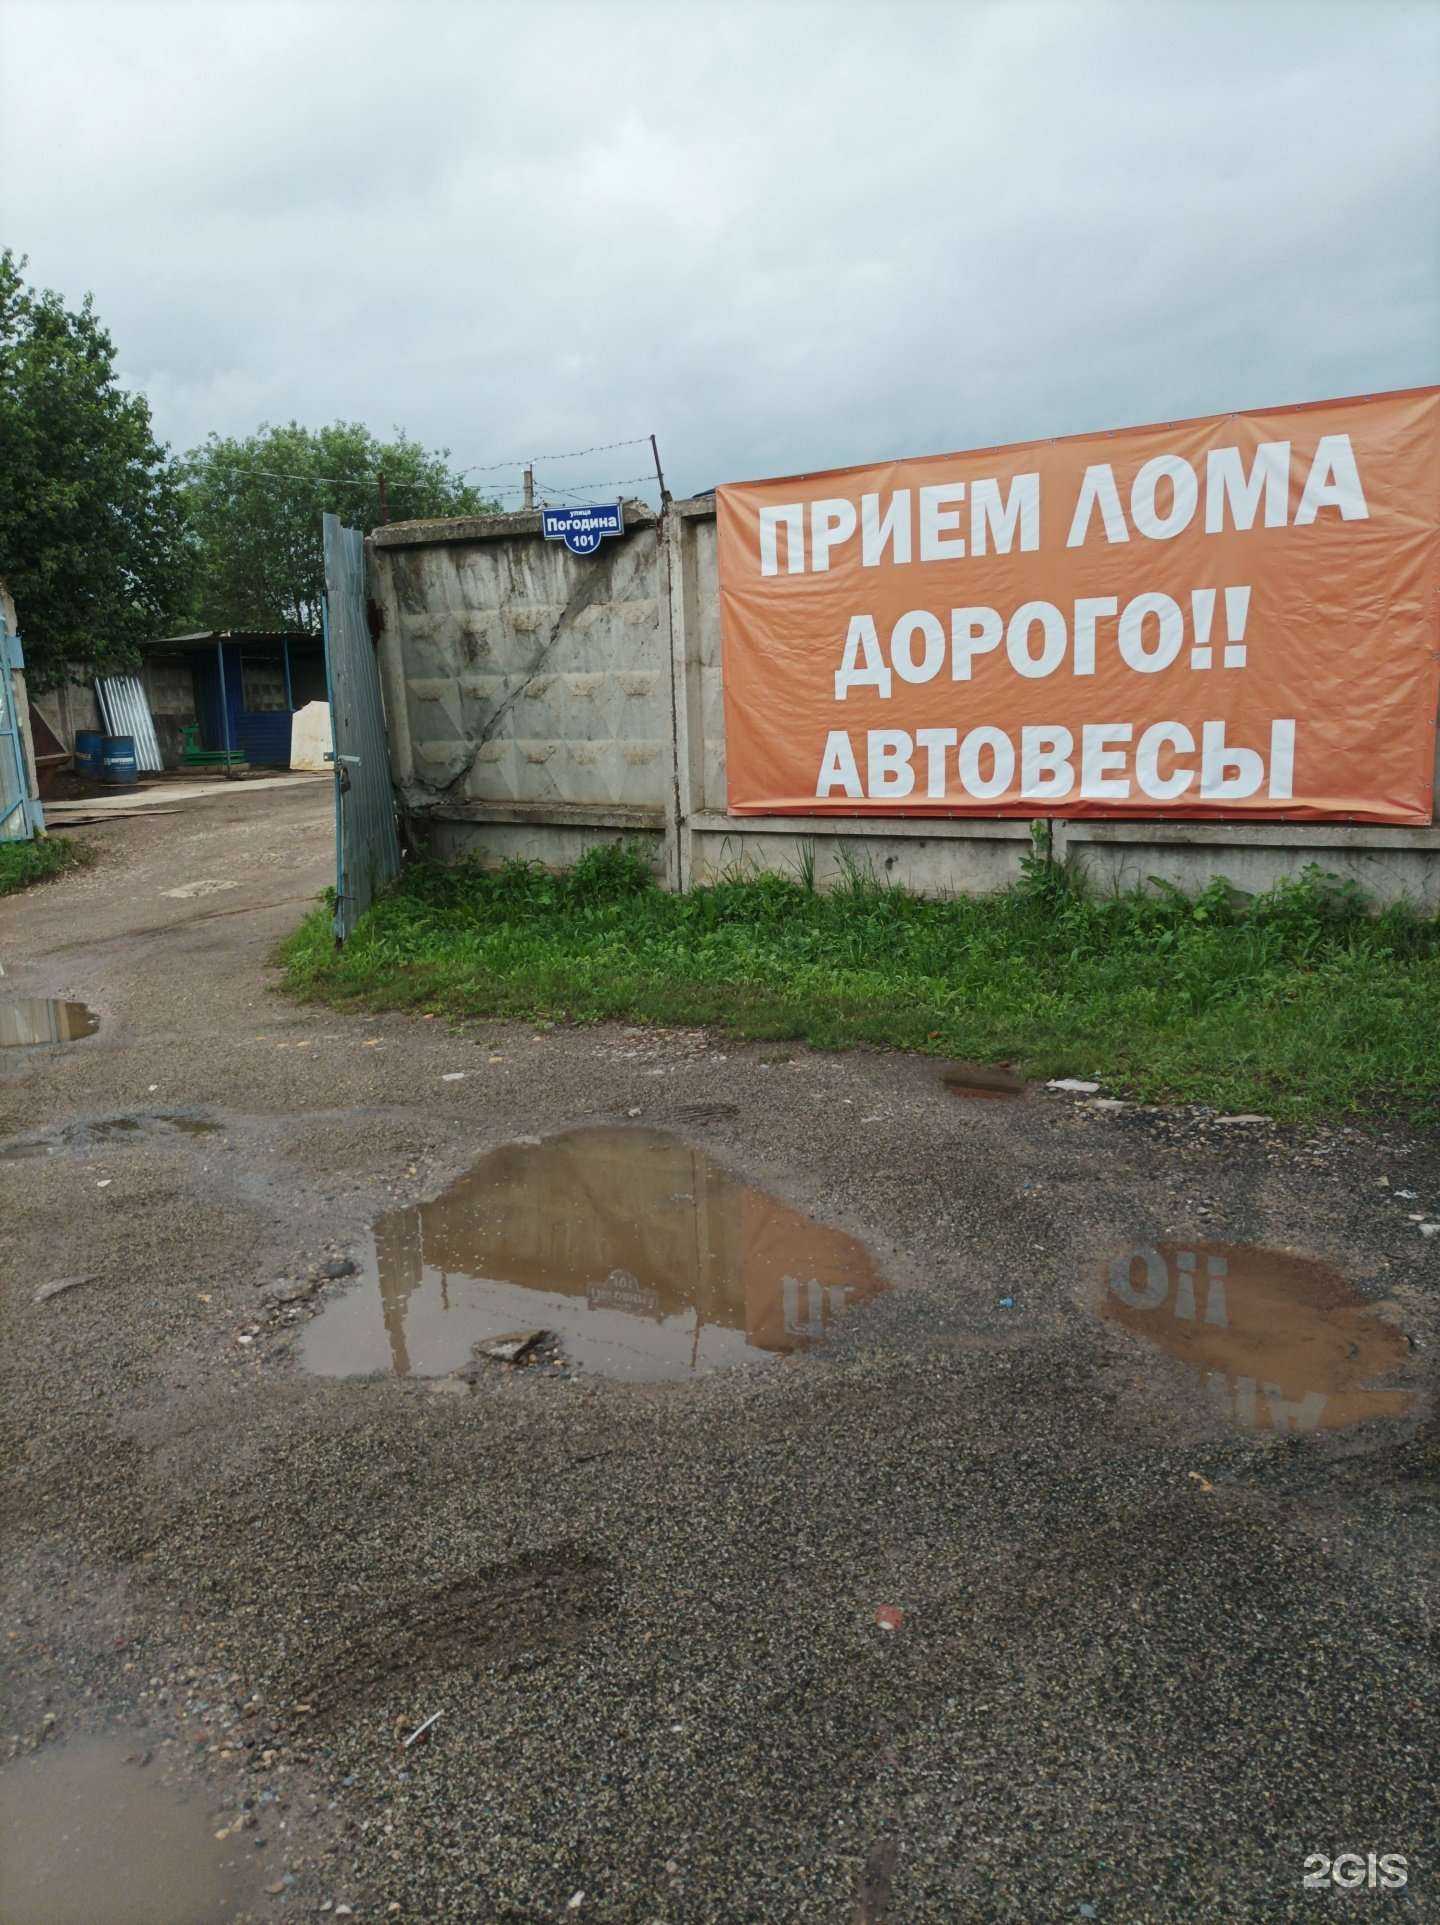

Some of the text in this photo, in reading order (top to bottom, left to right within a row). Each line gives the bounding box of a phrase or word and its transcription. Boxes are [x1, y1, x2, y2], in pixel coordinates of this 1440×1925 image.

[547, 516, 617, 531] Погодина
[570, 509, 591, 518] улица
[758, 434, 1369, 577] ПРИЕМ ЛОМА
[573, 535, 594, 547] 101
[834, 585, 1252, 700] ДОРОГО!!
[815, 718, 1296, 799] АВТОВЕСЫ
